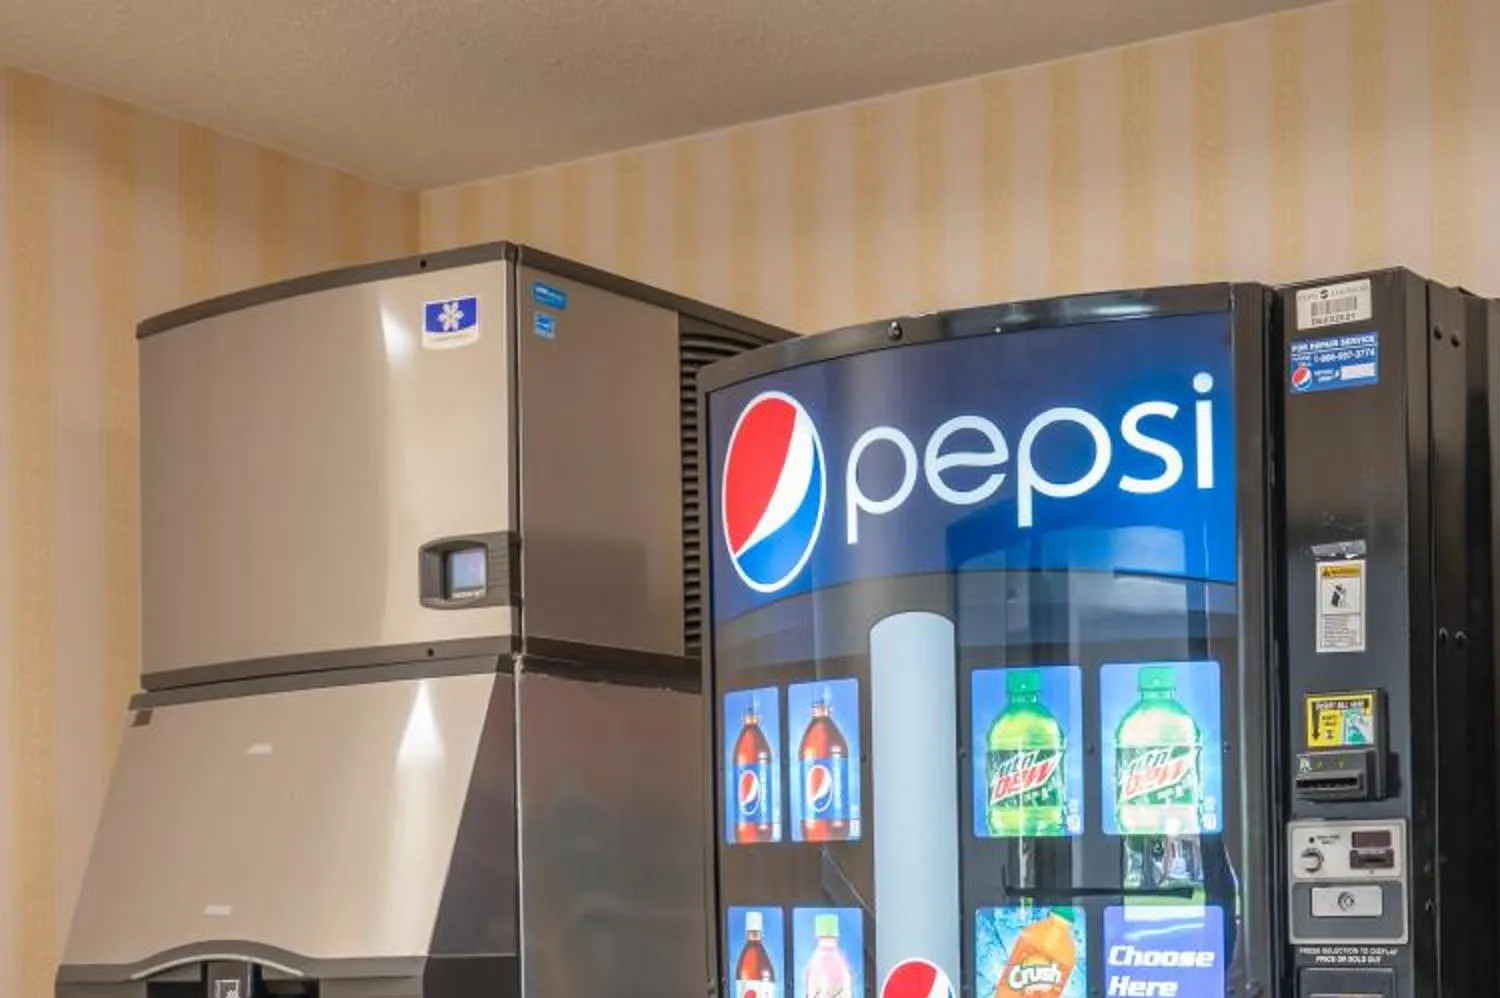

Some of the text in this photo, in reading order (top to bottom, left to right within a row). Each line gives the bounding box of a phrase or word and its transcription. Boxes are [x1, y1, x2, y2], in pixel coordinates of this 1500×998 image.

[846, 372, 1214, 544] pepsi
[1109, 945, 1215, 968] Choose
[1009, 962, 1062, 990] Crush
[1108, 975, 1179, 997] Here
